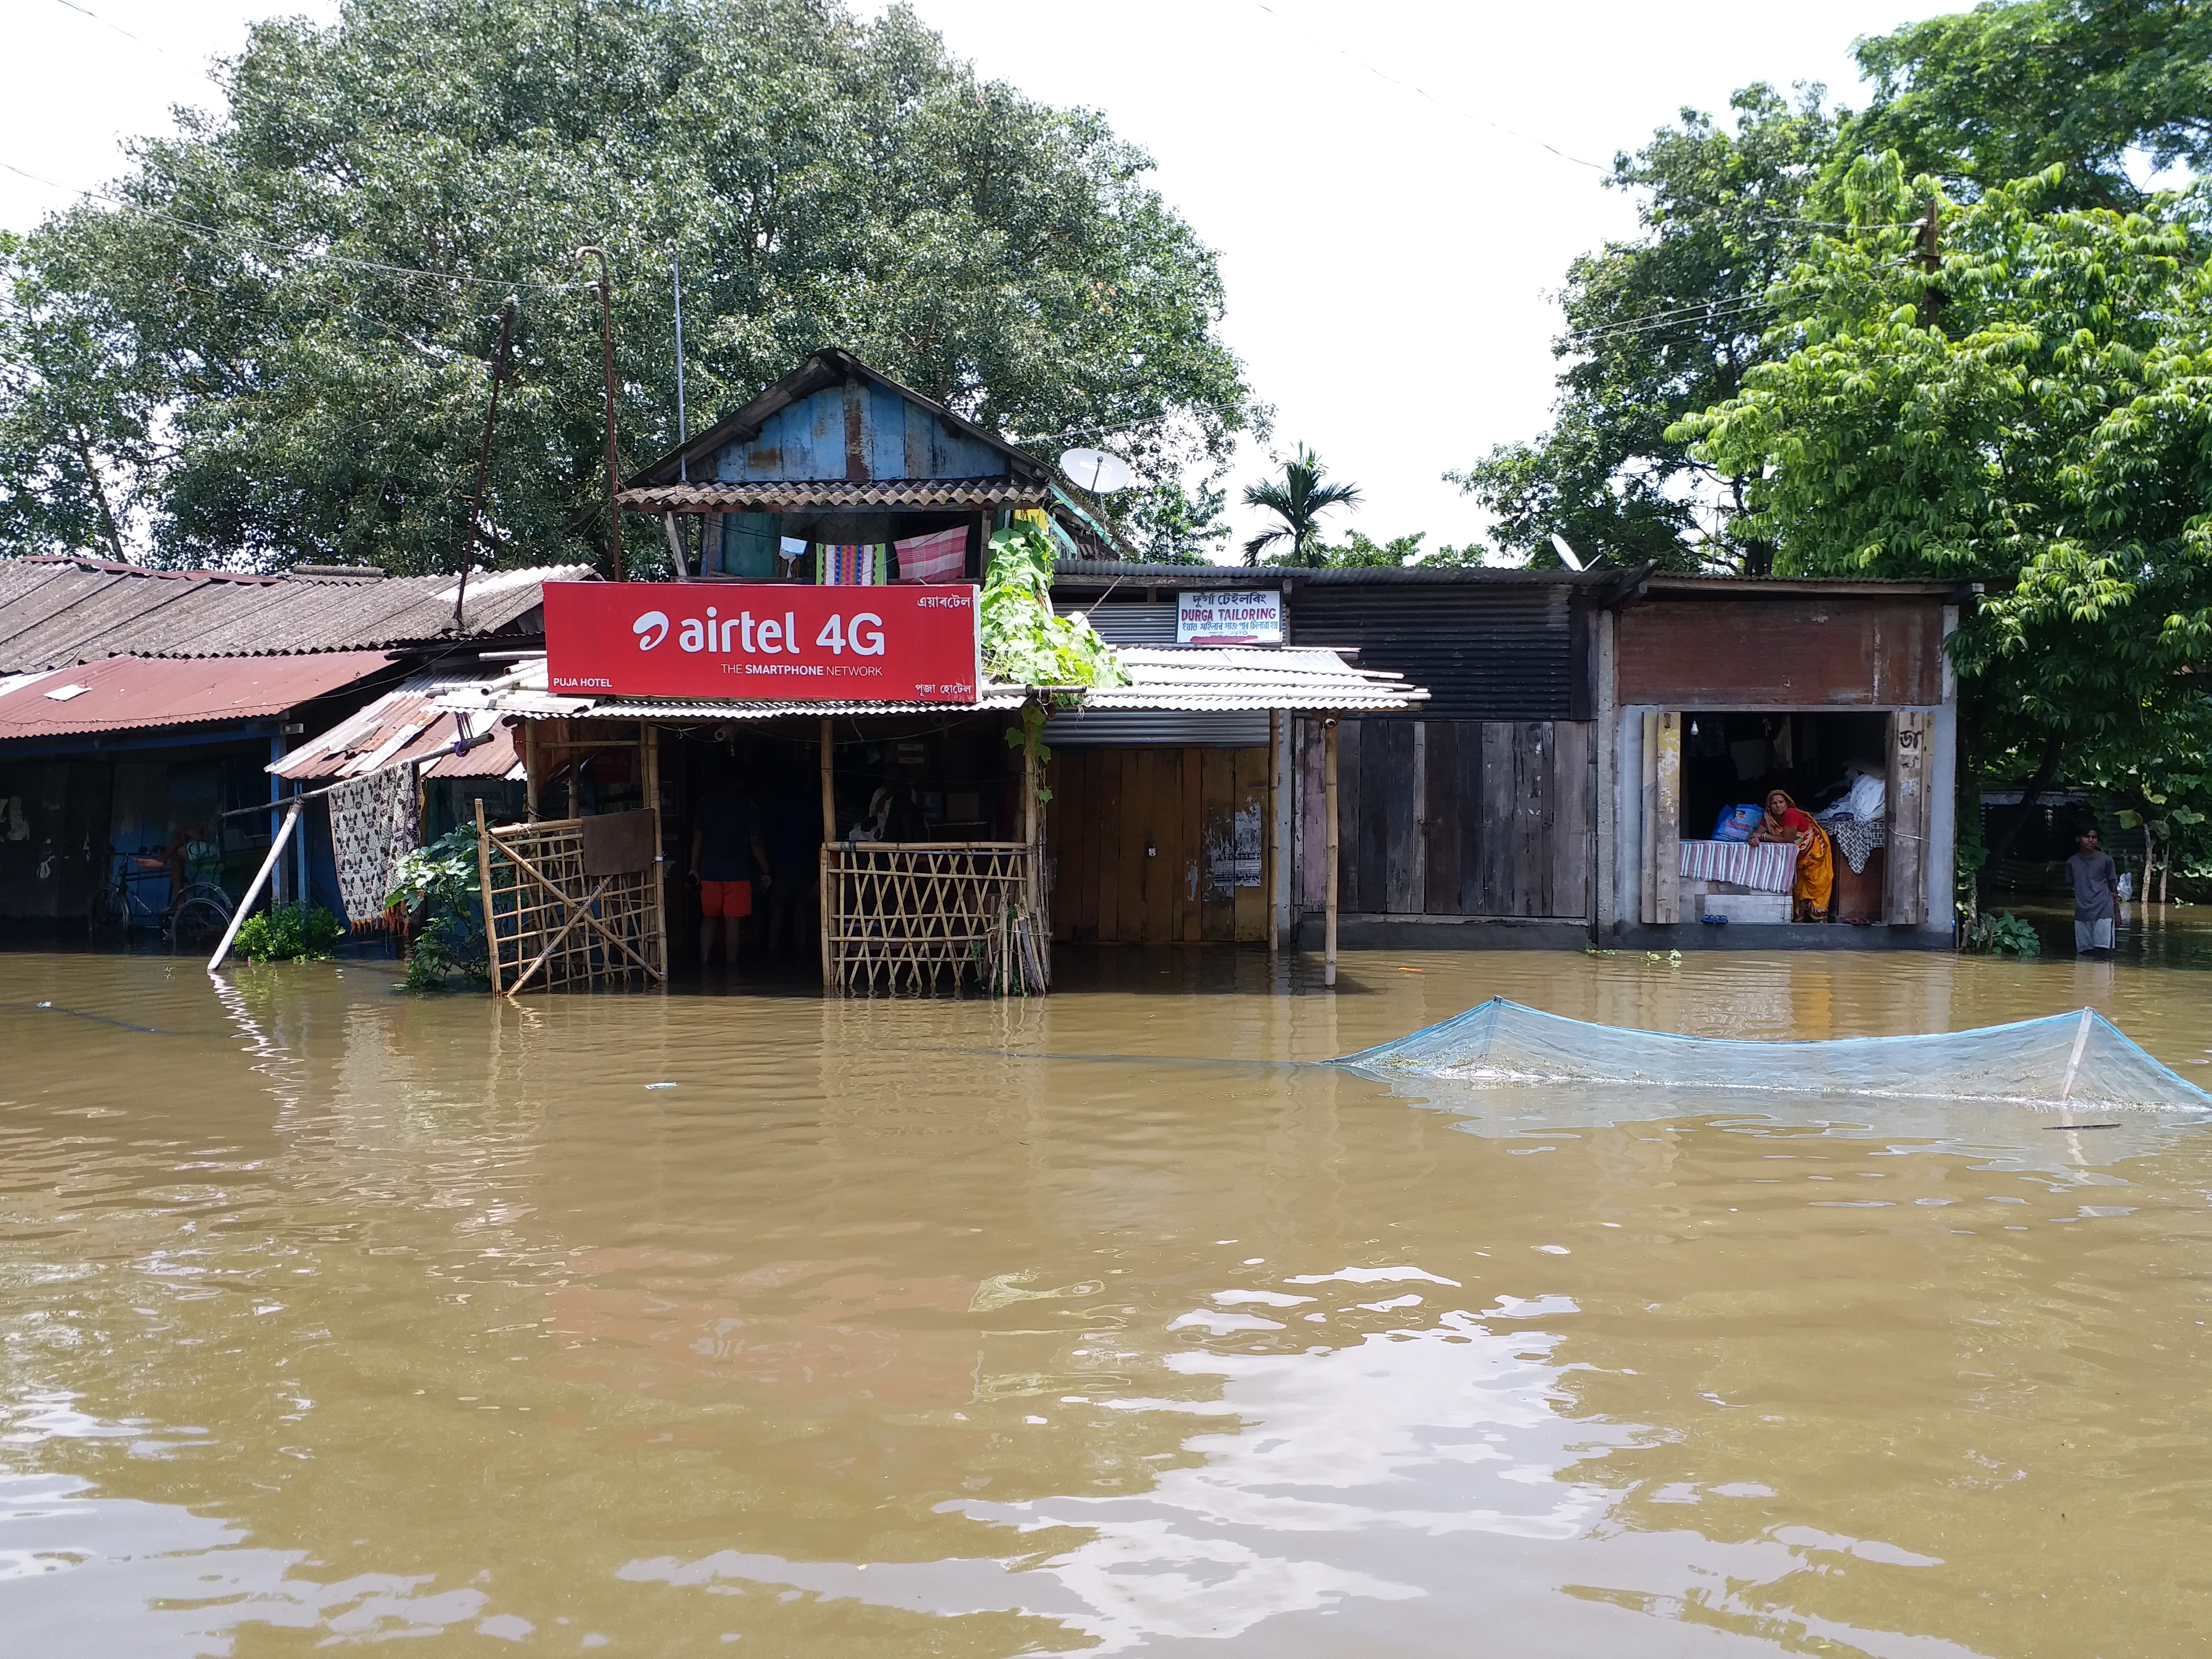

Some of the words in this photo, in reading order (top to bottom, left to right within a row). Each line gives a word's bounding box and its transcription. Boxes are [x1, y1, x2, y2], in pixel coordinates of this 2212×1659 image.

[1181, 609, 1213, 622] DURGA
[1218, 608, 1276, 621] TAILORING
[679, 606, 800, 654] airtel
[816, 612, 885, 656] 4G
[720, 663, 743, 674] THE
[745, 664, 824, 675] SMARTPHONE
[826, 666, 883, 676] NETWORK
[553, 677, 578, 686] PUJA
[580, 678, 613, 687] HOTEL
[940, 682, 972, 695] হোটেল
